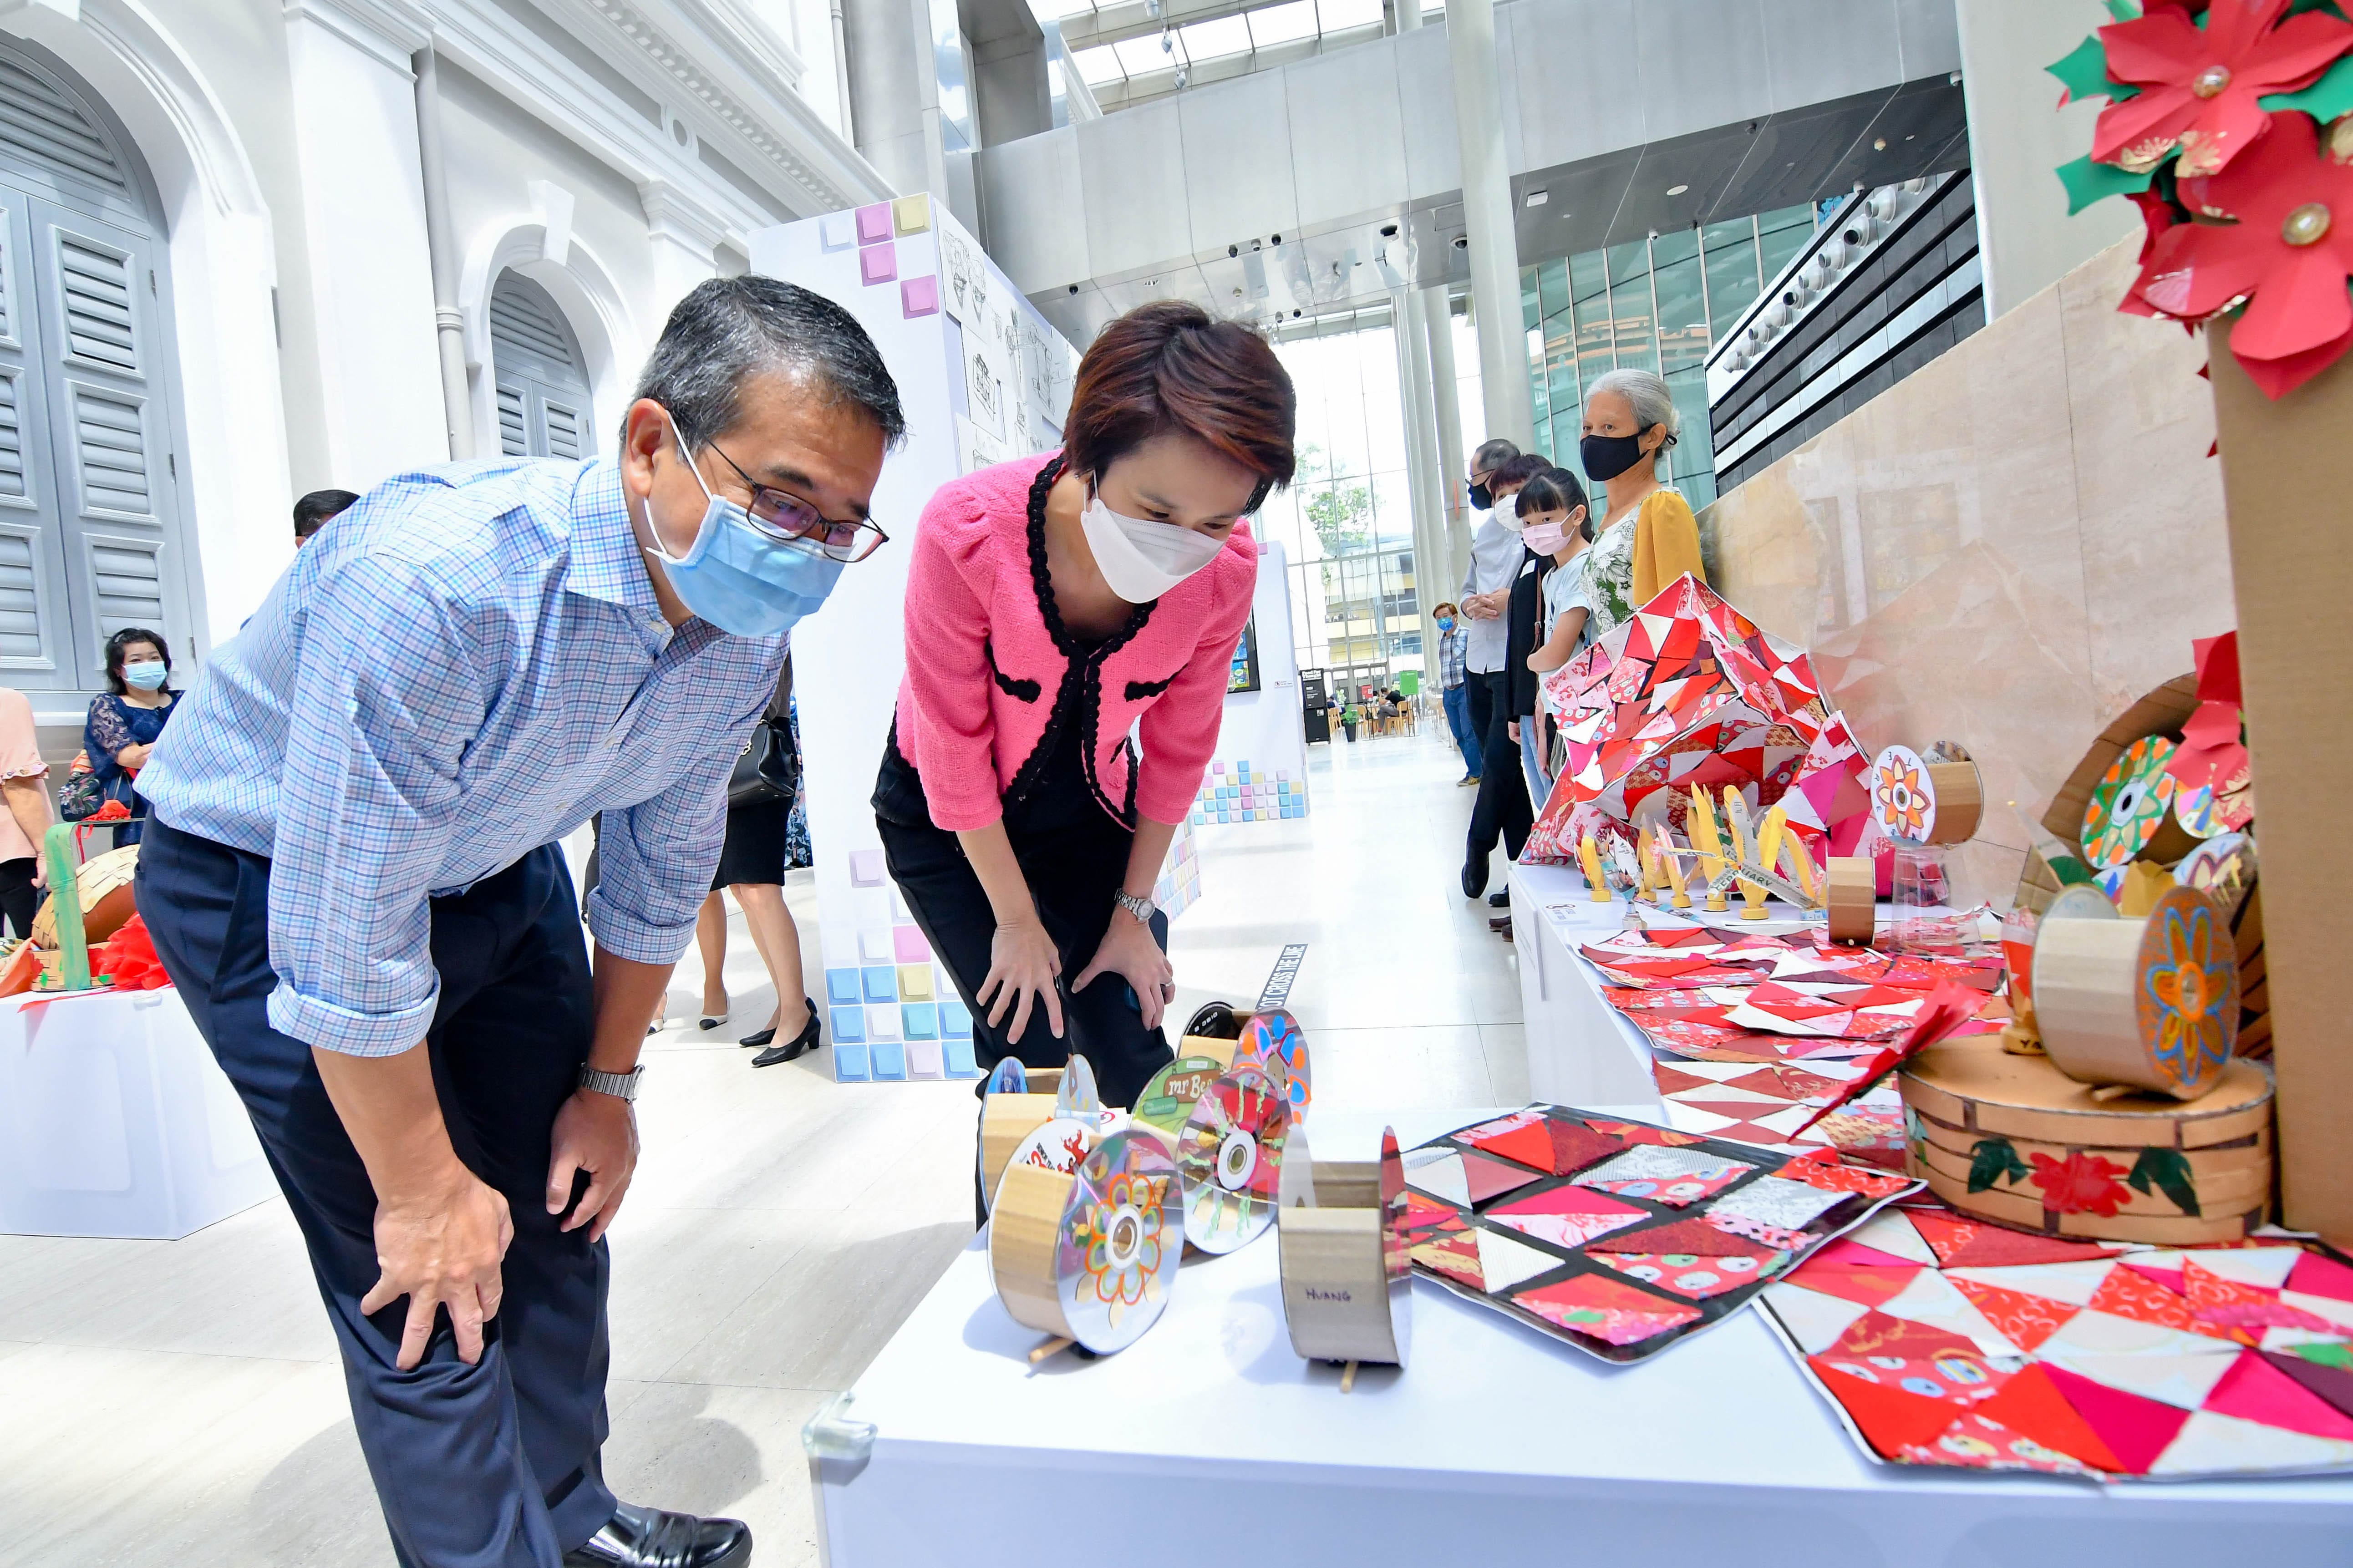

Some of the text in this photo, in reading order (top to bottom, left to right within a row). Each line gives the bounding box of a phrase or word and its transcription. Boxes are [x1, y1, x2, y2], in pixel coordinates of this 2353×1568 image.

[1281, 946, 1305, 959] LINE
[1275, 959, 1300, 972] THE
[1265, 971, 1295, 995] CROSS
[1168, 1079, 1189, 1096] mr
[1305, 1288, 1352, 1303] HUANG
